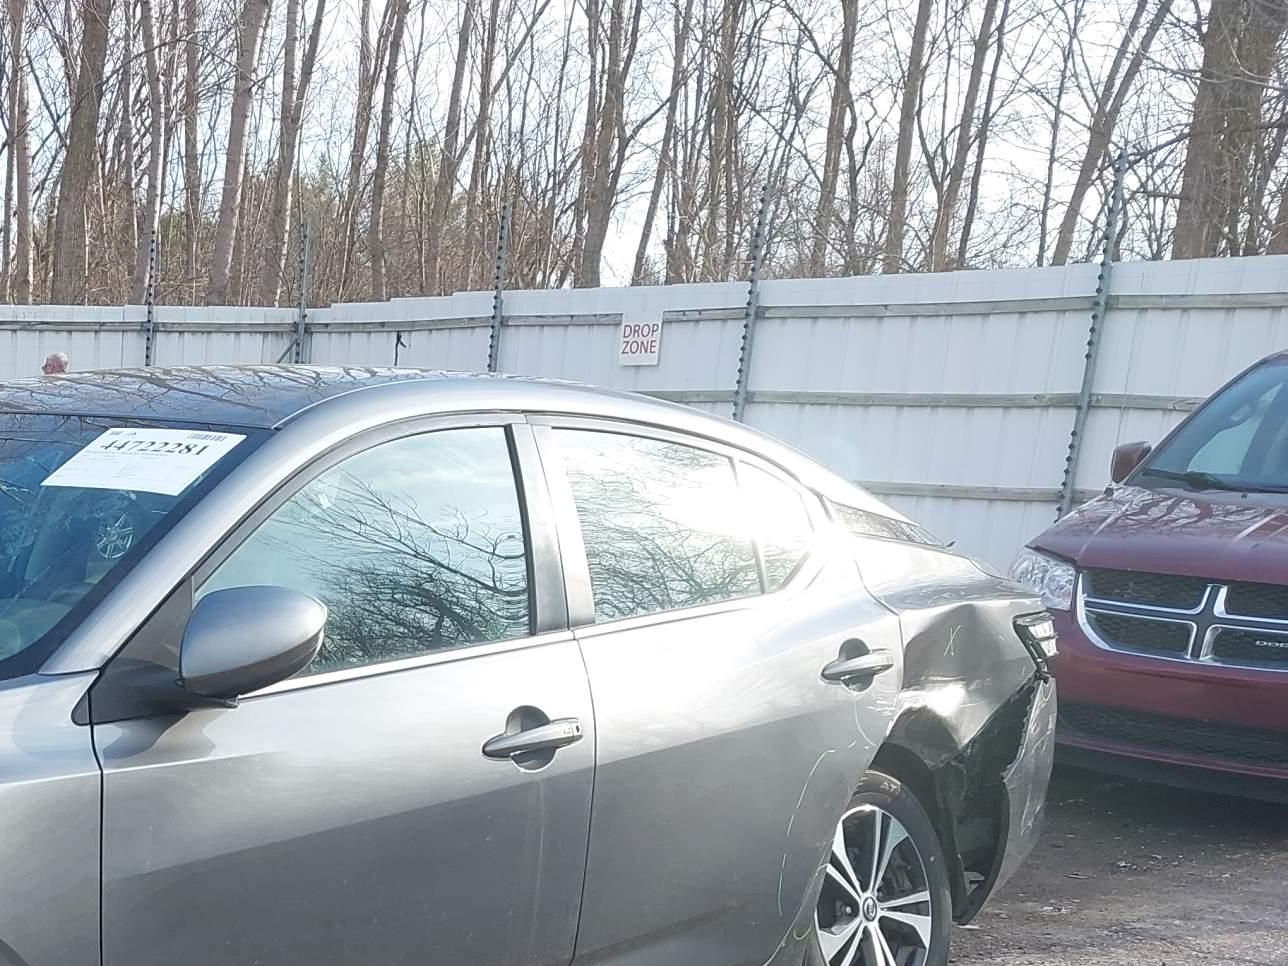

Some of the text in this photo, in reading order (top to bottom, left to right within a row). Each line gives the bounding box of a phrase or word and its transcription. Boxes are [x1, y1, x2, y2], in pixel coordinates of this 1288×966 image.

[622, 323, 660, 338] DROP
[621, 339, 657, 354] ZONE
[99, 438, 210, 456] 44722281
